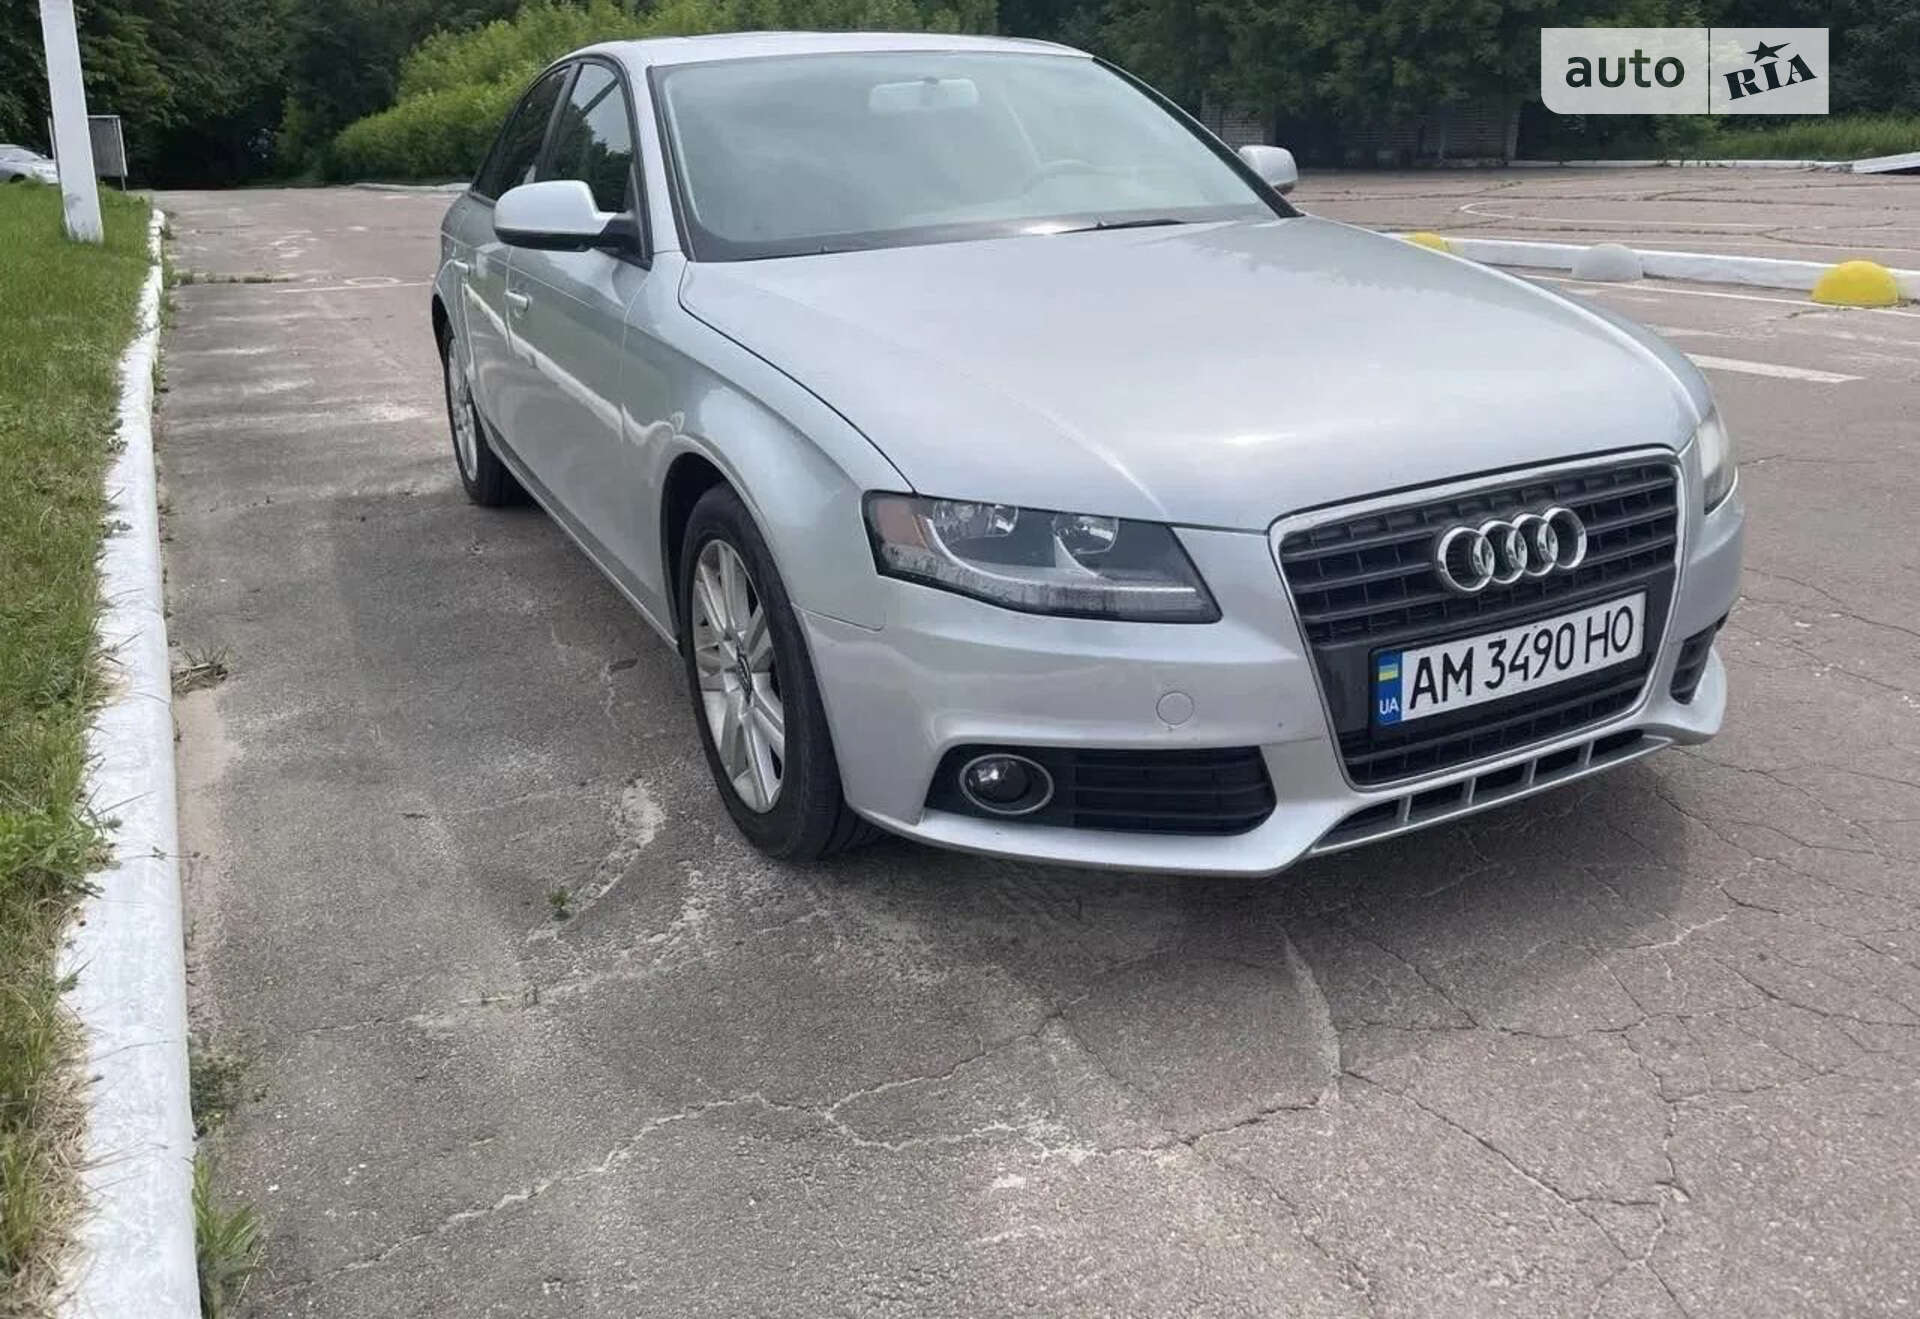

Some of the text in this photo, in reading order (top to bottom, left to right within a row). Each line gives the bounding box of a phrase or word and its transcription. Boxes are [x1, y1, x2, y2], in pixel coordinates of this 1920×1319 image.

[1408, 605, 1634, 709] AM 3490 HO
[1379, 700, 1400, 715] UA
